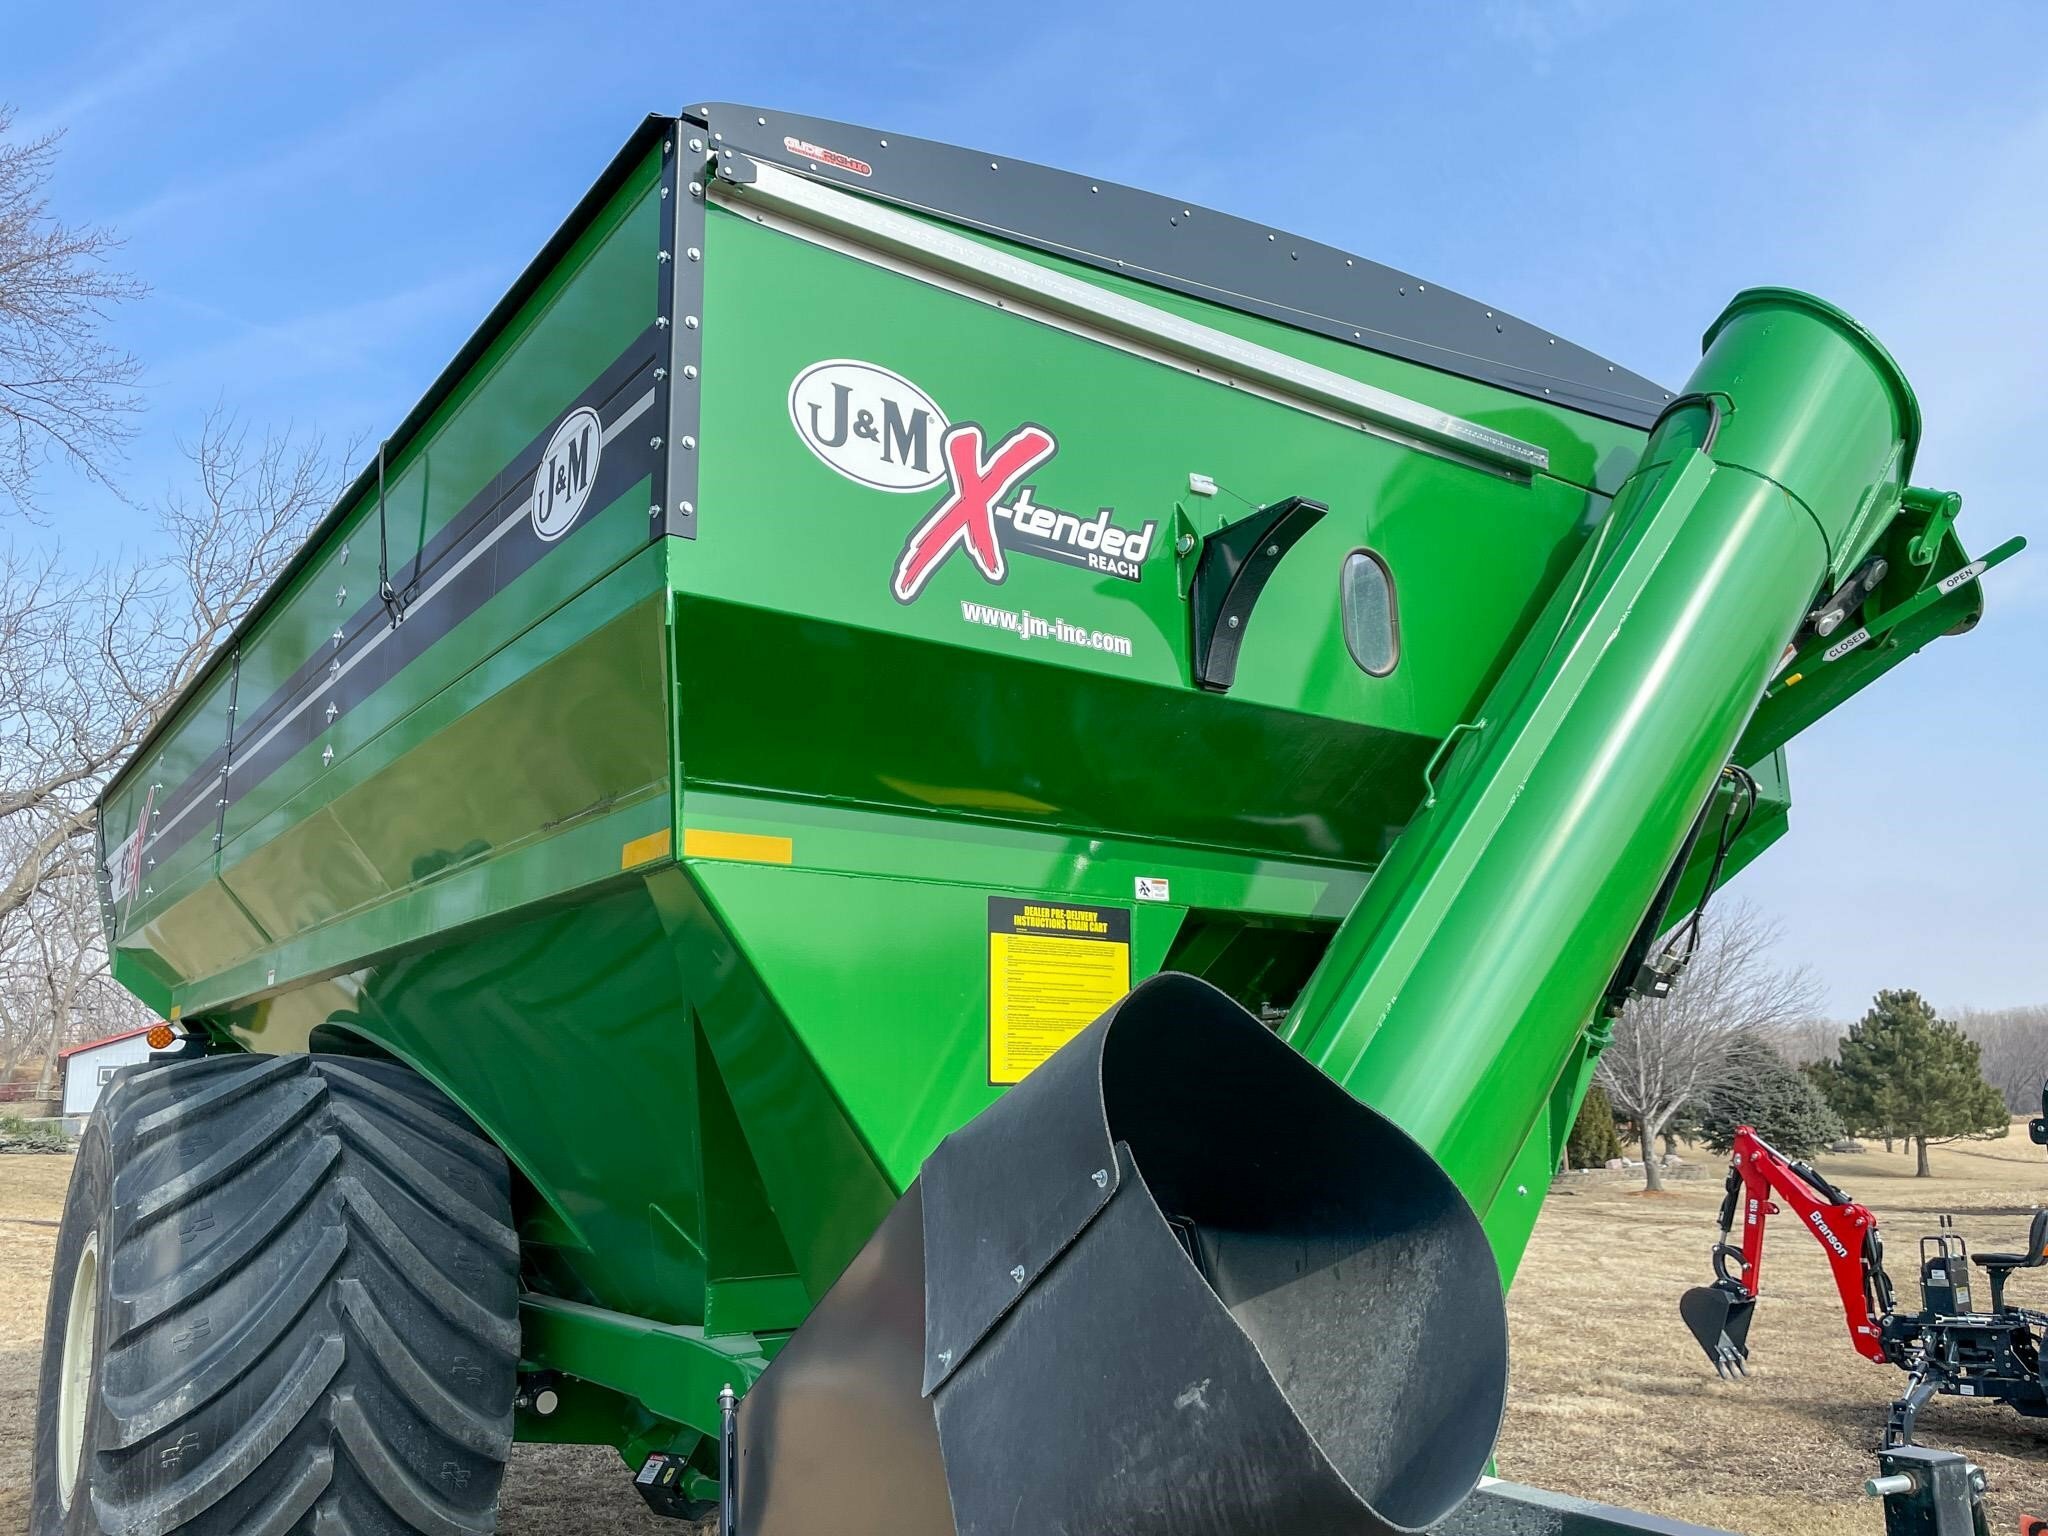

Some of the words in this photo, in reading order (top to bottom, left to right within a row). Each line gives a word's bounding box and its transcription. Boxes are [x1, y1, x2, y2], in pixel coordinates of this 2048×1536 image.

[807, 381, 931, 475] J&M
[538, 423, 591, 524] J&M
[1087, 552, 1140, 580] REACH
[1946, 567, 1974, 588] OPEN
[961, 602, 1133, 656] www.jm-inc.com
[1828, 630, 1867, 659] CLOSED
[1014, 915, 1065, 930] INSTRUCTIONS
[1066, 919, 1089, 932] GRAIN
[1090, 921, 1108, 933] CART
[1024, 906, 1050, 917] DEALER
[1051, 908, 1098, 921] PRE-DELIVERY
[1809, 1210, 1848, 1258] Branson
